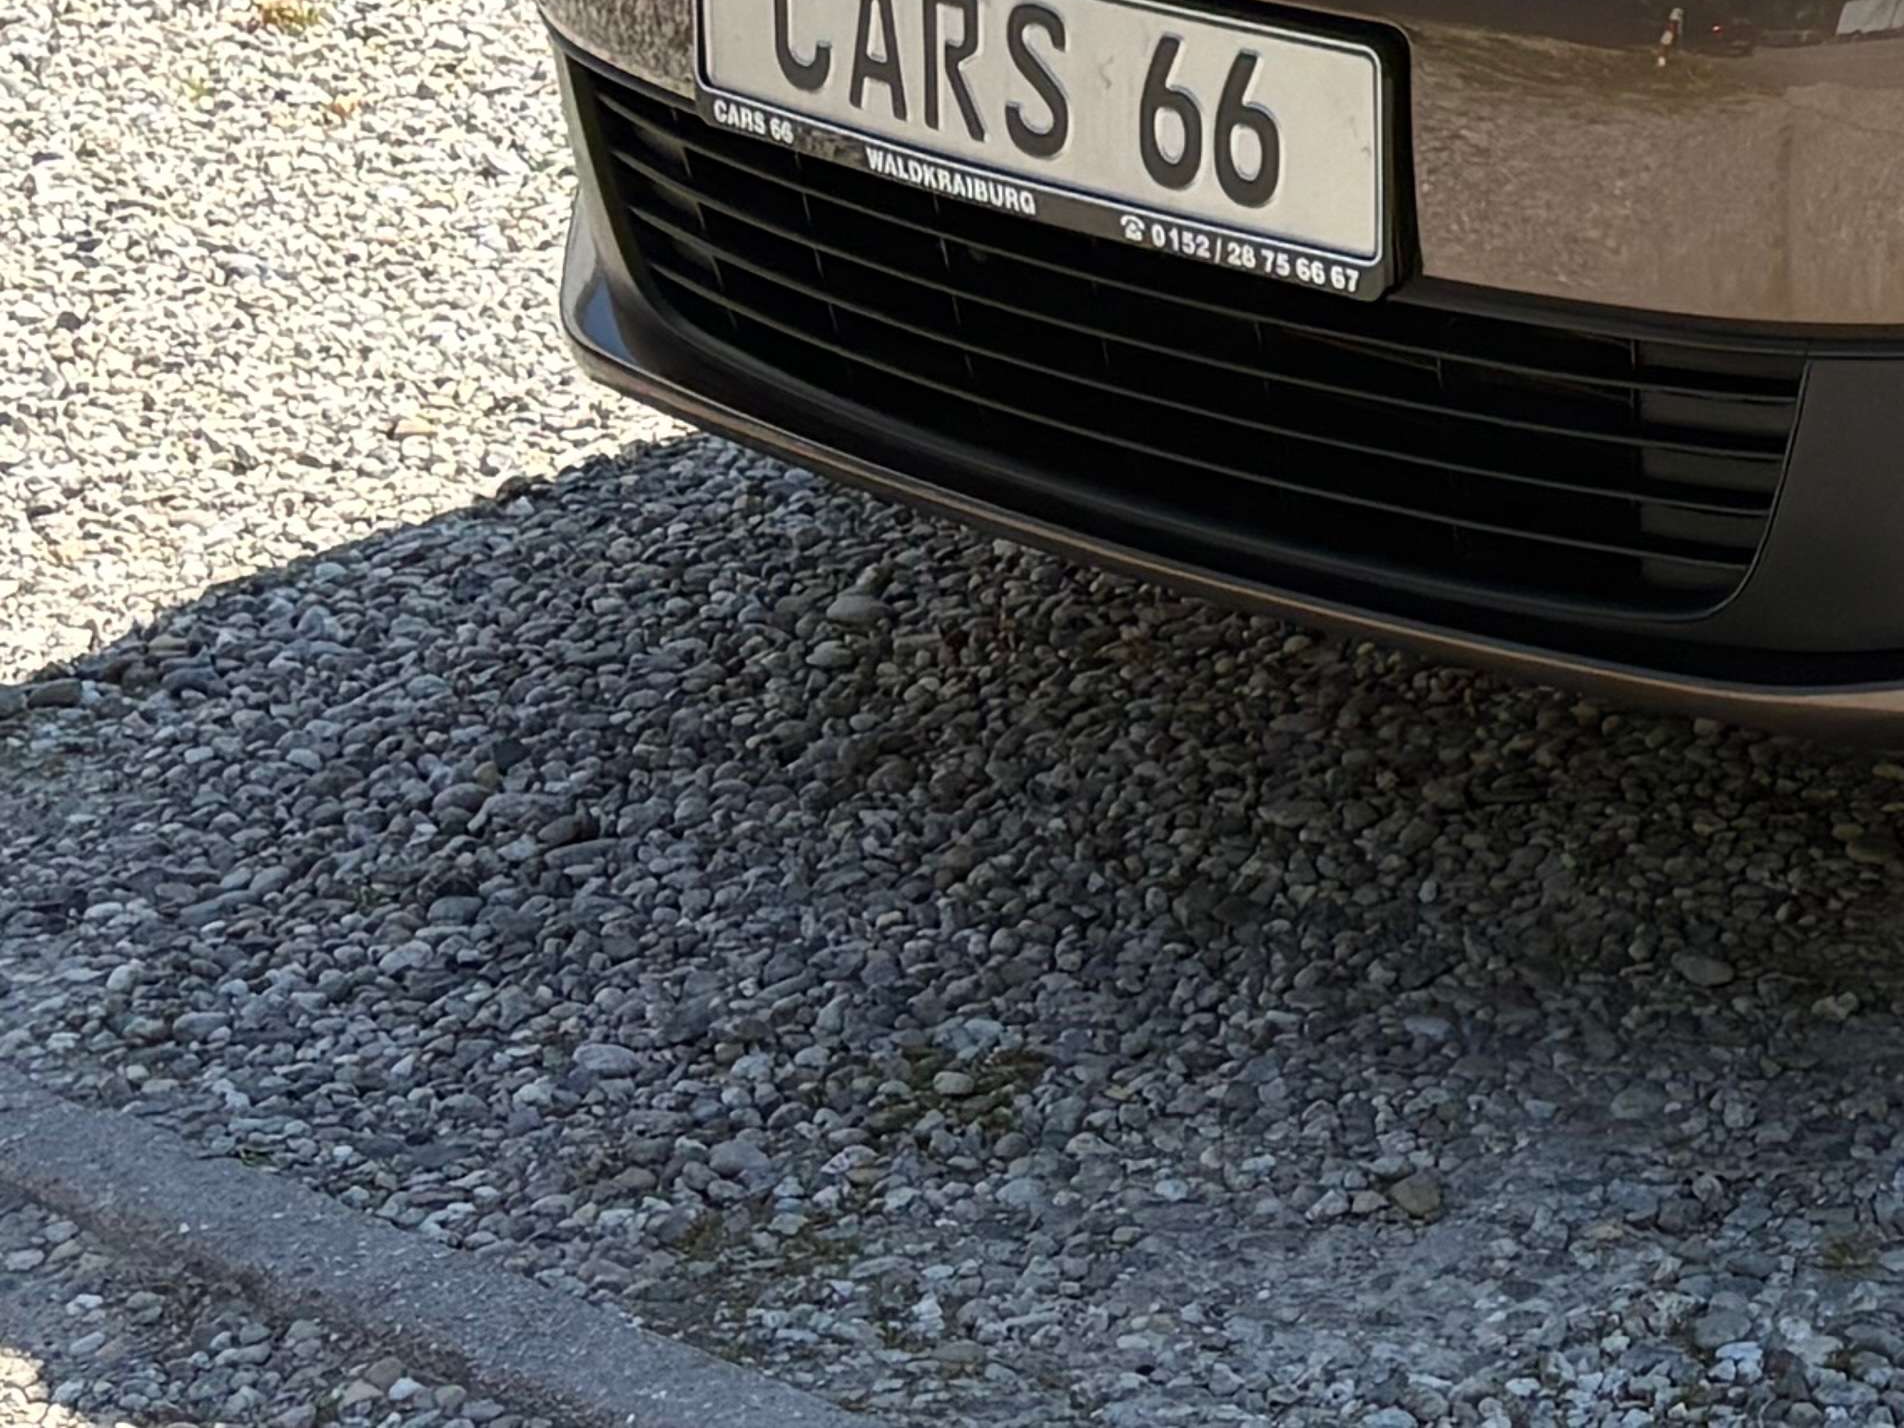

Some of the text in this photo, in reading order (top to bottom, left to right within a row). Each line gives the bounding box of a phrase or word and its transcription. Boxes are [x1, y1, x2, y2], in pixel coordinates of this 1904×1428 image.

[713, 99, 794, 144] CARS 66
[1139, 35, 1280, 208] 66
[864, 146, 1036, 216] WALDKRAIBURG
[1151, 224, 1211, 259] 0152
[1227, 242, 1257, 269] 28
[1261, 249, 1290, 277] 75
[1296, 258, 1325, 285] 66
[1330, 266, 1359, 293] 67
